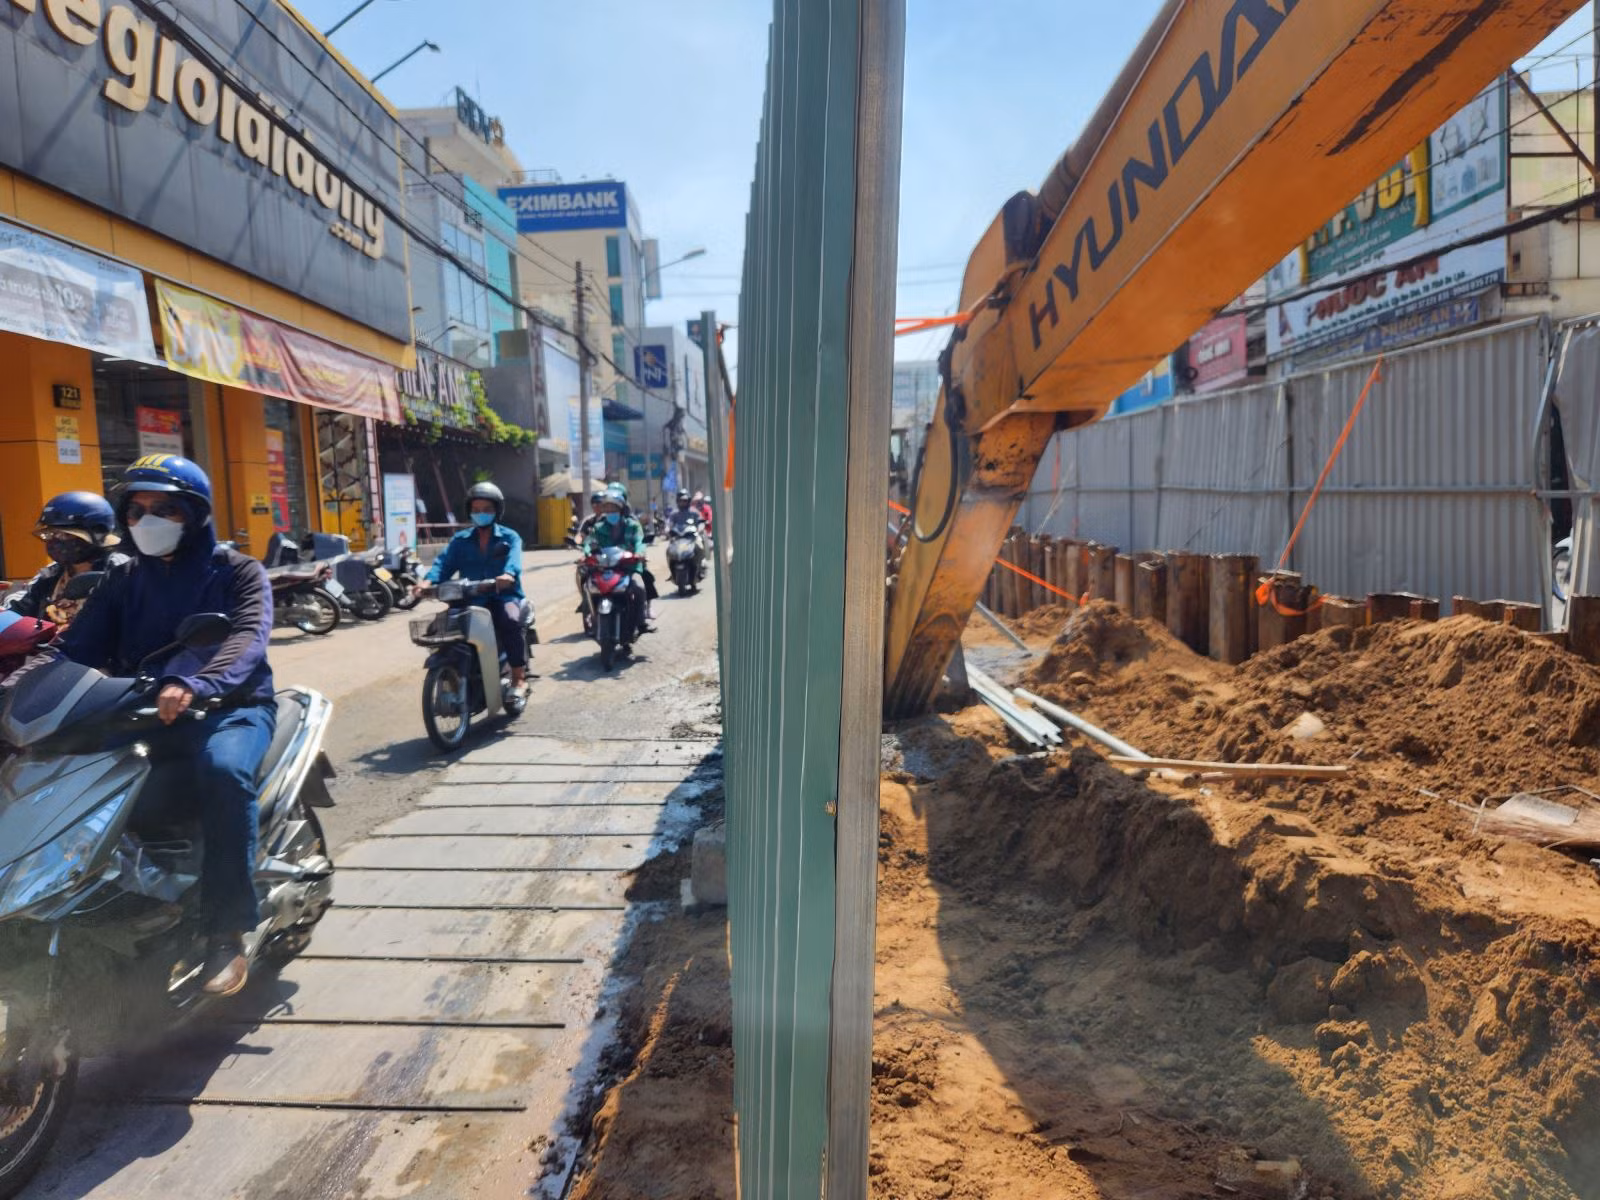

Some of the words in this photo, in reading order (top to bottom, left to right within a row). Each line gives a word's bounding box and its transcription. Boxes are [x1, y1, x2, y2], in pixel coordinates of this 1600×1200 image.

[1029, 0, 1299, 350] HYUNDA
[506, 190, 618, 212] EXIMBANK
[61, 386, 78, 398] 121
